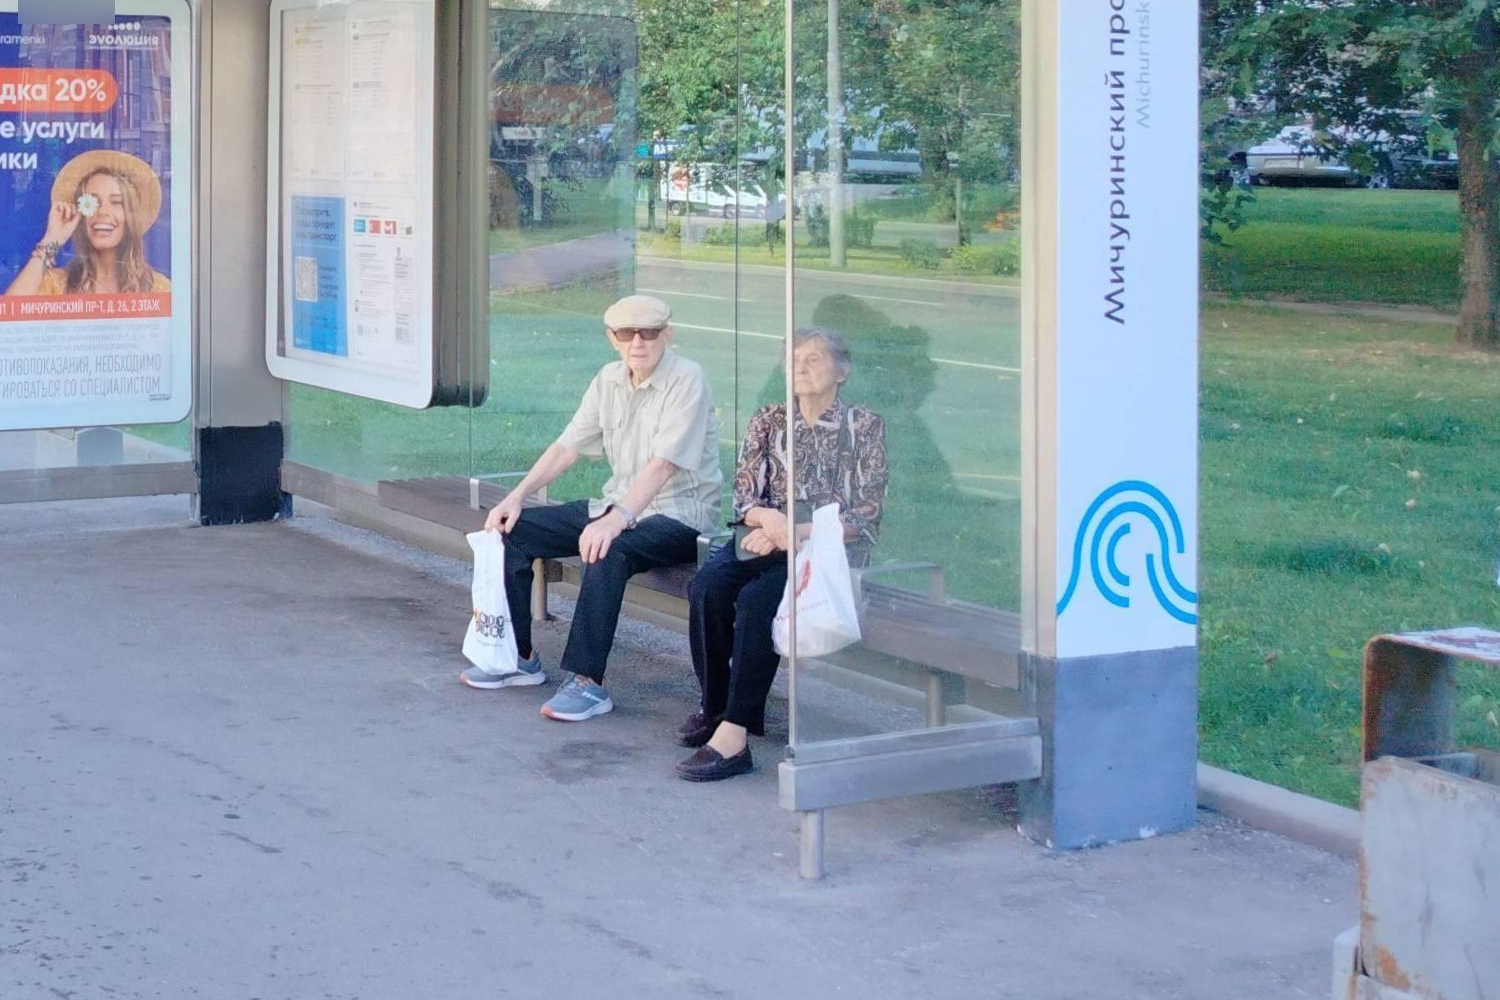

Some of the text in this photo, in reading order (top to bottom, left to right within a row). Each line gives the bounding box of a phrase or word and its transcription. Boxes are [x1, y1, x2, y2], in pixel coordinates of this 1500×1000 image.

[54, 77, 107, 103] 20%
[22, 121, 105, 144] услуги
[1103, 70, 1131, 326] Мичуринский
[20, 299, 84, 315] МИЧУРИНСКИЙ
[131, 299, 137, 312] 2
[138, 298, 161, 312] ЭТАЖ
[95, 353, 162, 374] НЕОБХОДИМО
[64, 379, 77, 398] СО
[80, 376, 161, 399] СПЕЦИАЛИСТОМ
